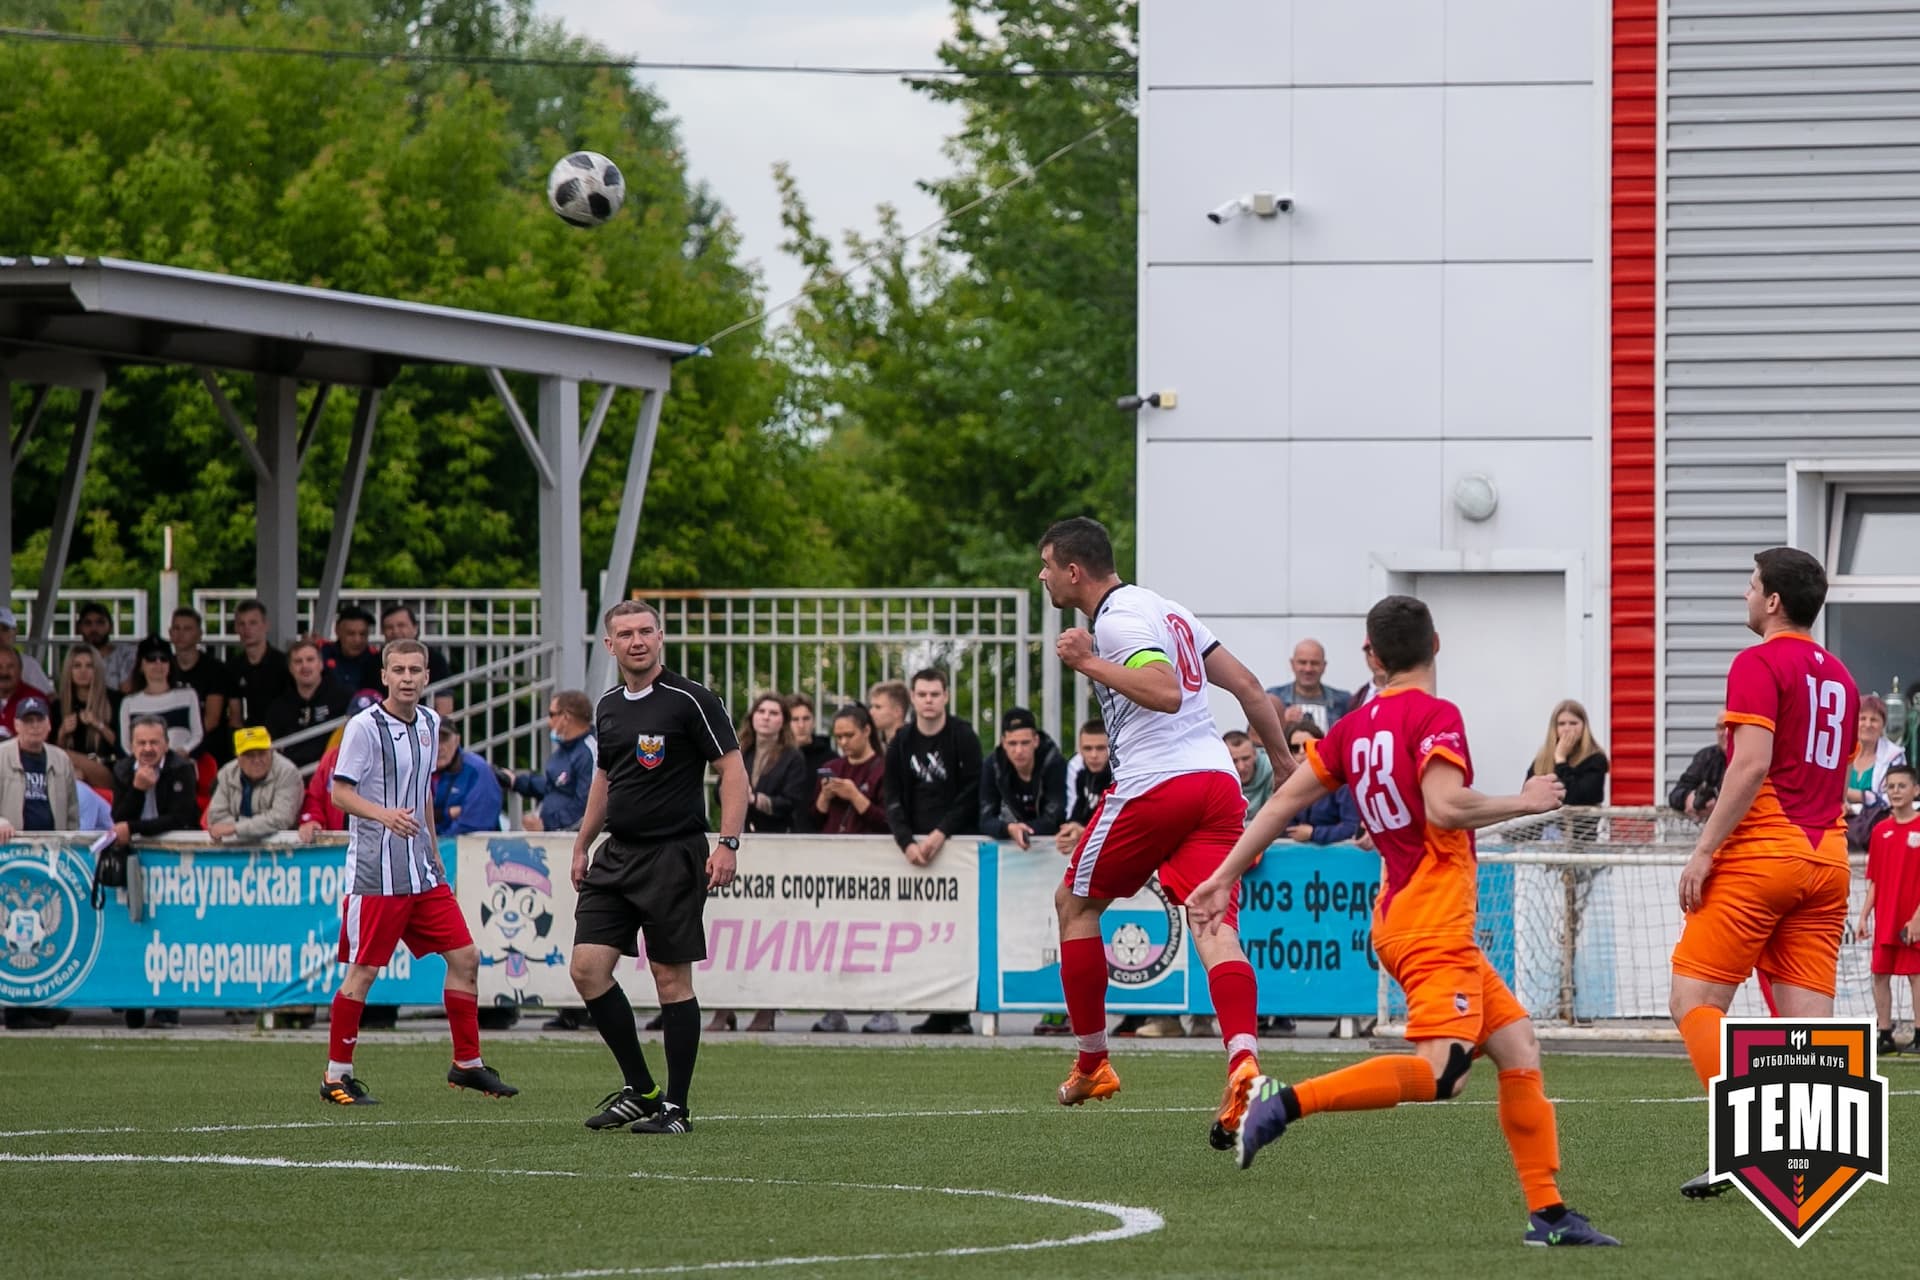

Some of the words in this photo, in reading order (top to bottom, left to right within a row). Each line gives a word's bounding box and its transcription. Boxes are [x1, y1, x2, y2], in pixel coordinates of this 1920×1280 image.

[1806, 673, 1846, 769] 13
[1351, 730, 1412, 834] 23
[781, 874, 891, 908] спортивная
[897, 876, 959, 902] школа
[1303, 870, 1380, 921] феде
[144, 929, 292, 996] федерация
